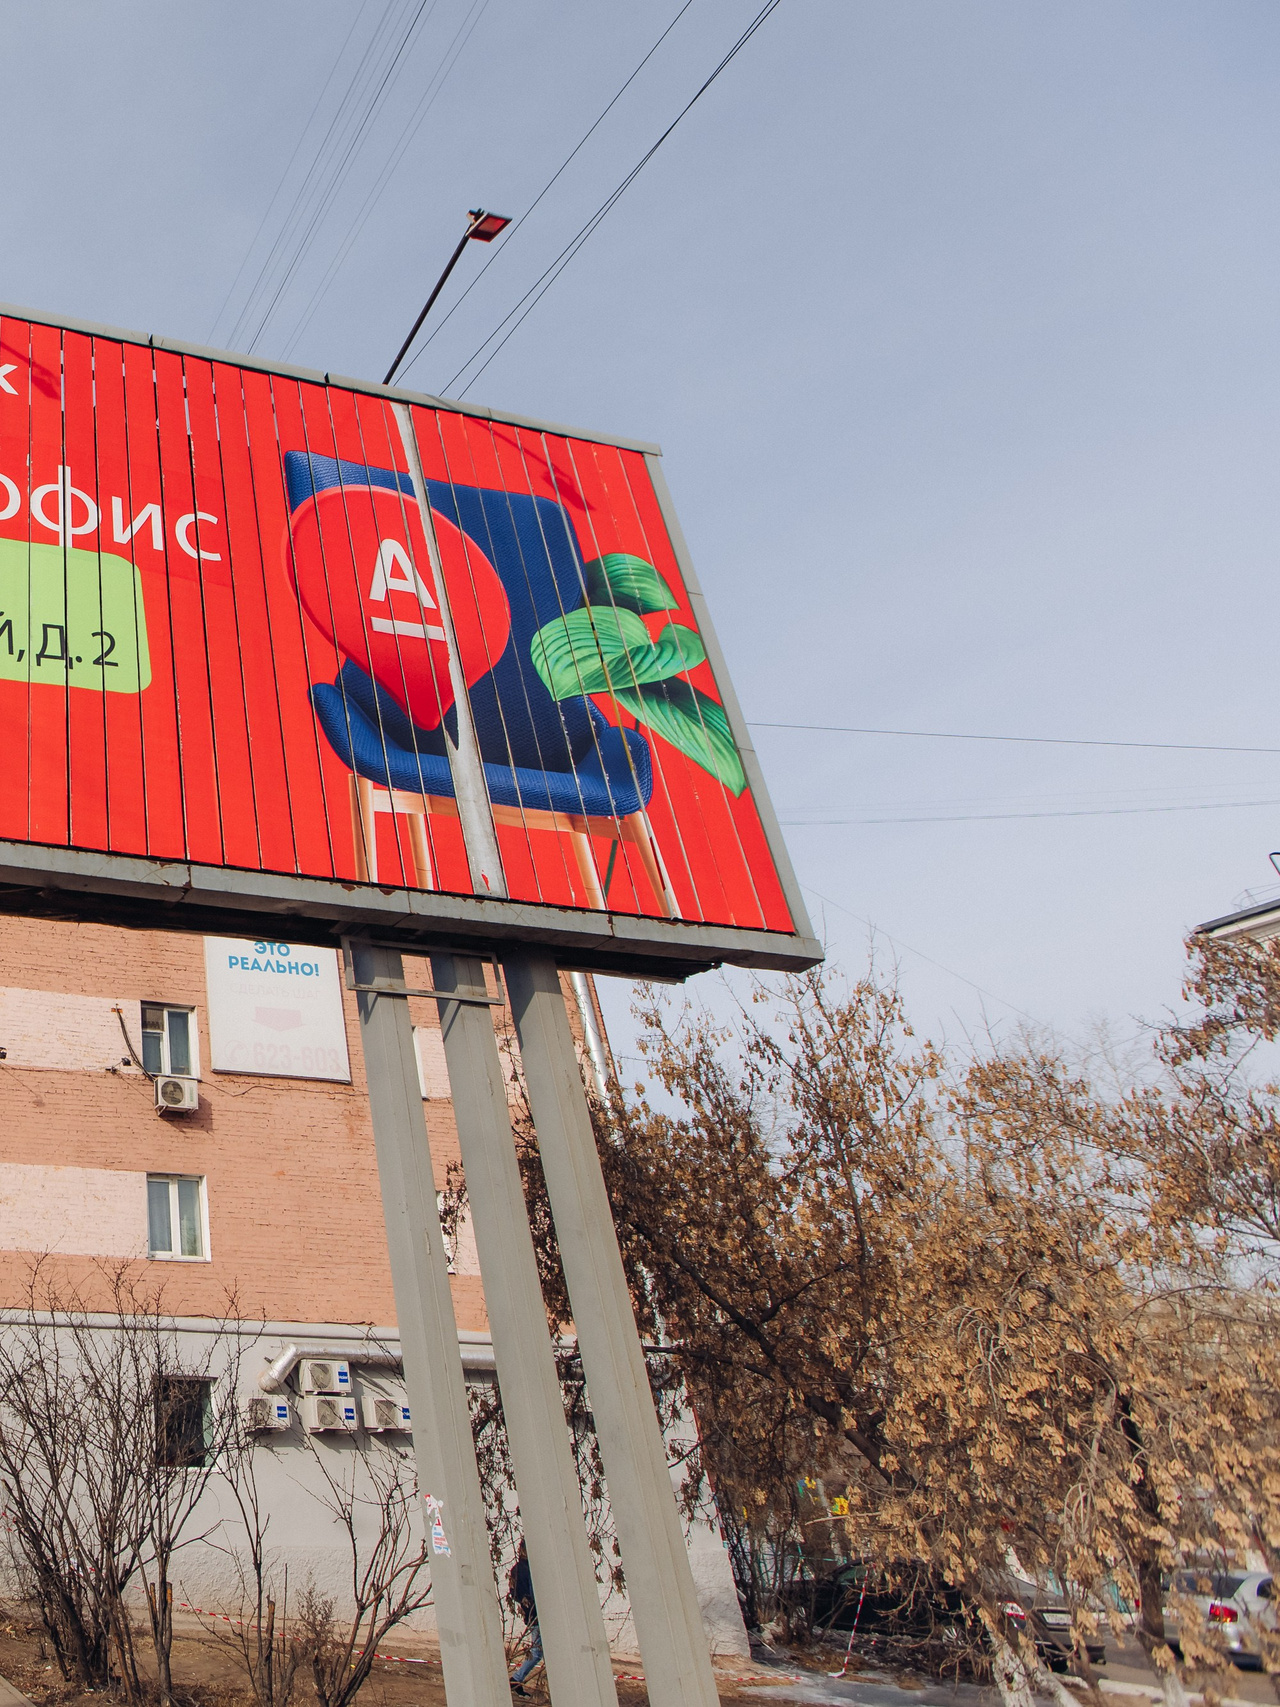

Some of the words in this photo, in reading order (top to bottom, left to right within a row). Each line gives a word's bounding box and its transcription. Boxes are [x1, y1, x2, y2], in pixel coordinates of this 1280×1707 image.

[91, 630, 120, 669] 2
[253, 941, 291, 957] ЭТО
[228, 955, 320, 977] РЕАЛЬНО!
